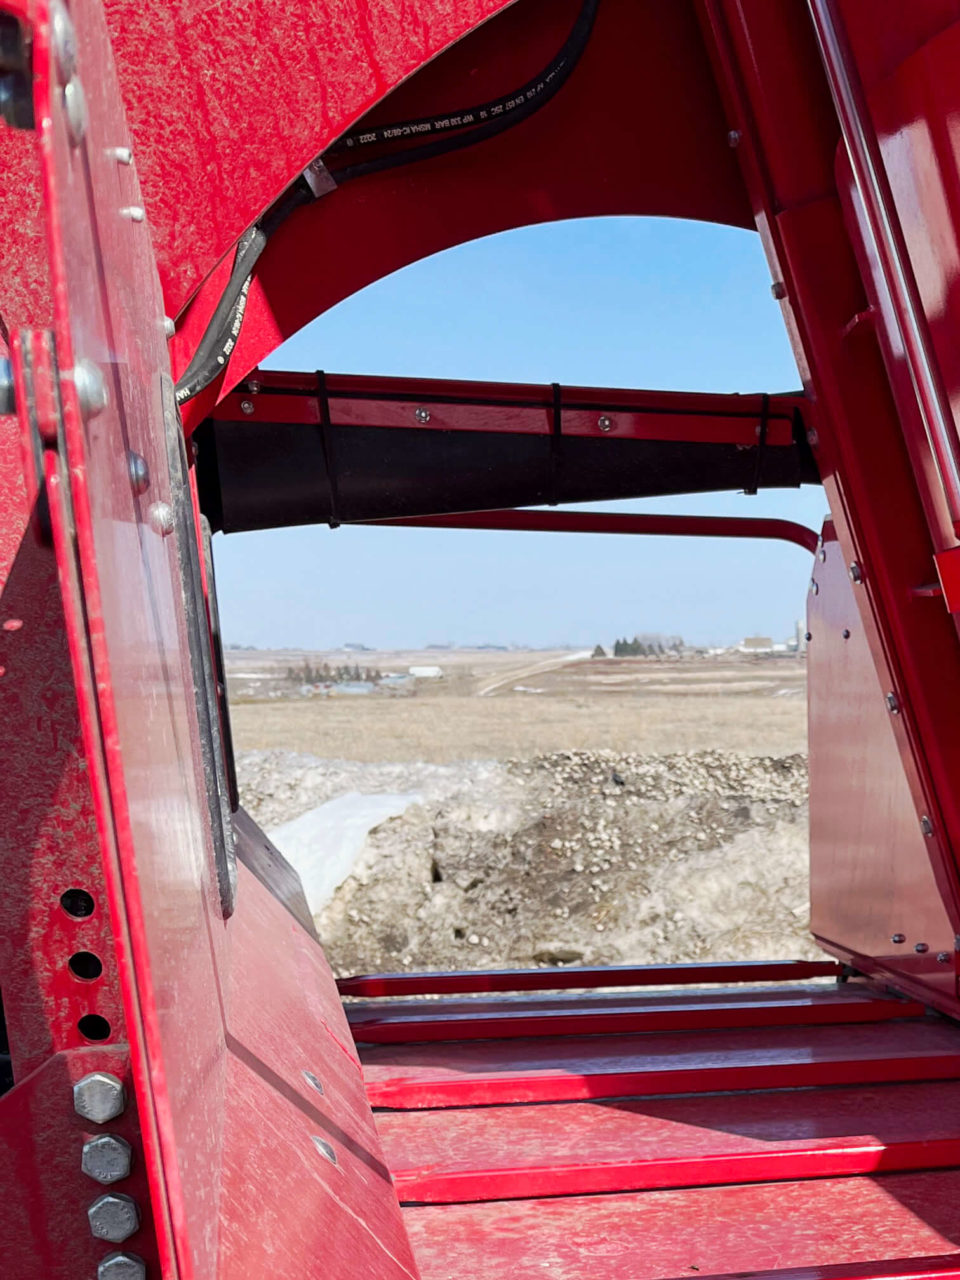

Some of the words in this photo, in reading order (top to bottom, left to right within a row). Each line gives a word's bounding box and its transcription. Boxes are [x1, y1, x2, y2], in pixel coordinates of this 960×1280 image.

[434, 119, 450, 129] BAR
[462, 114, 474, 124] WP
[410, 123, 431, 133] MSHA
